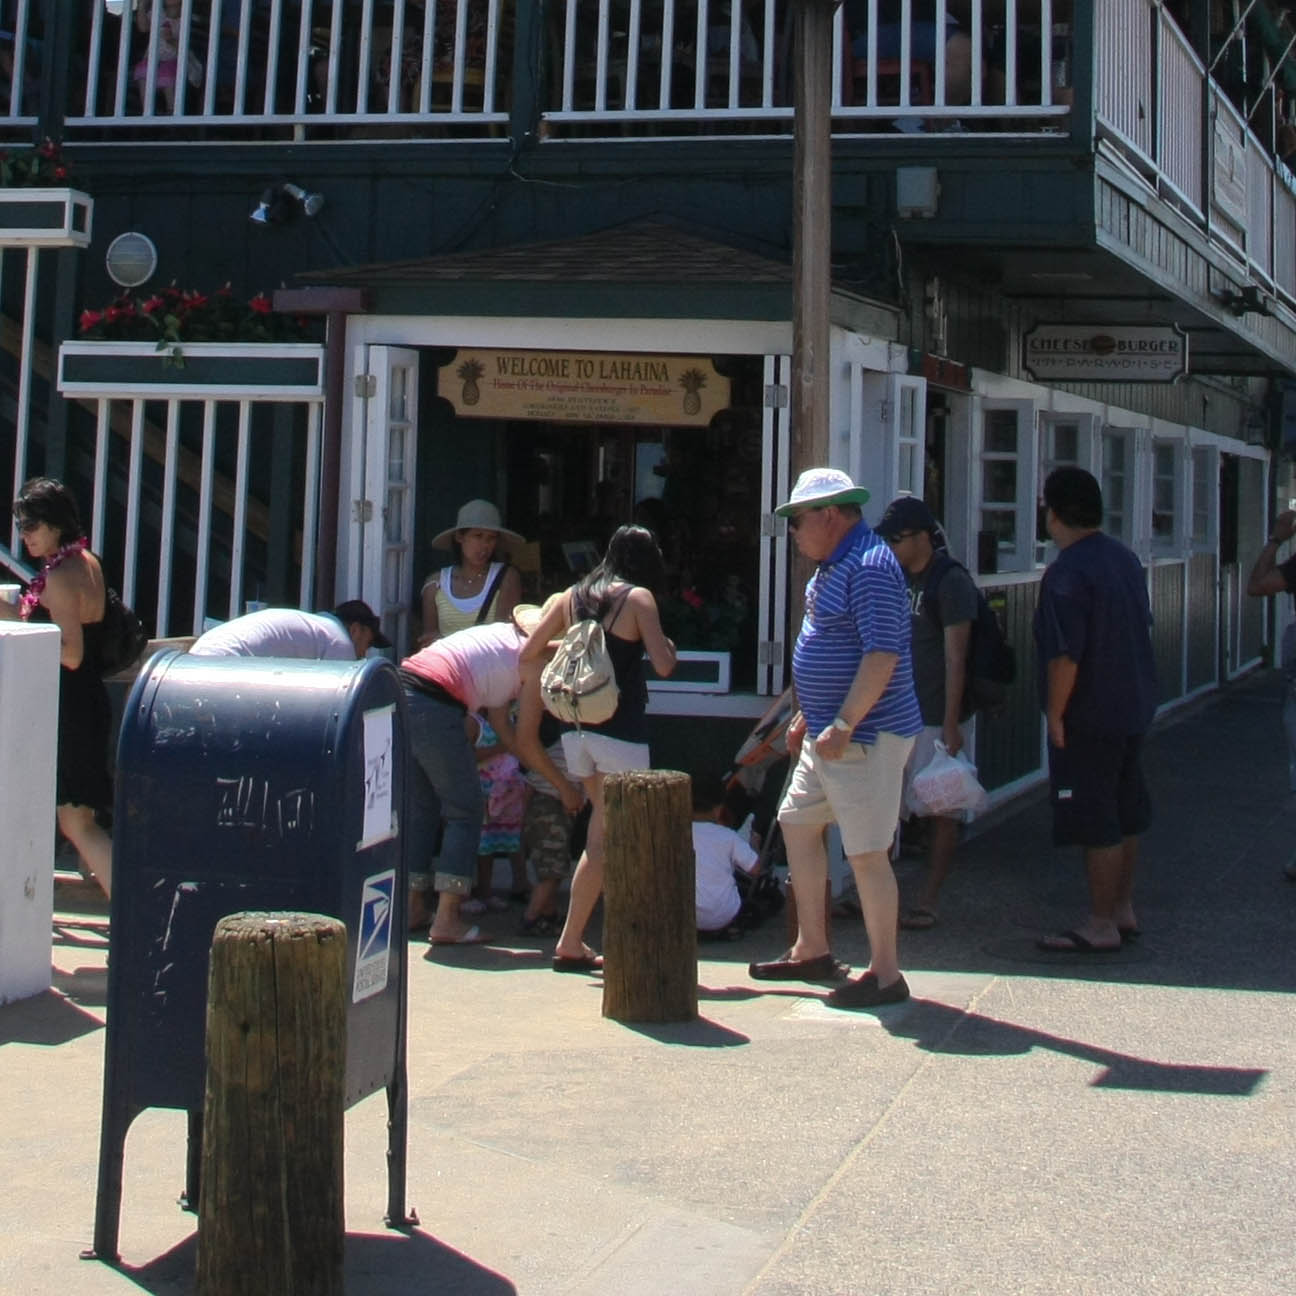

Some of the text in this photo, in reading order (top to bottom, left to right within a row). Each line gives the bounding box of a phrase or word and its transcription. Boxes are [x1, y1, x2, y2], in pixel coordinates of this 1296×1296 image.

[496, 356, 671, 382] WELCOME TO LAHAINA
